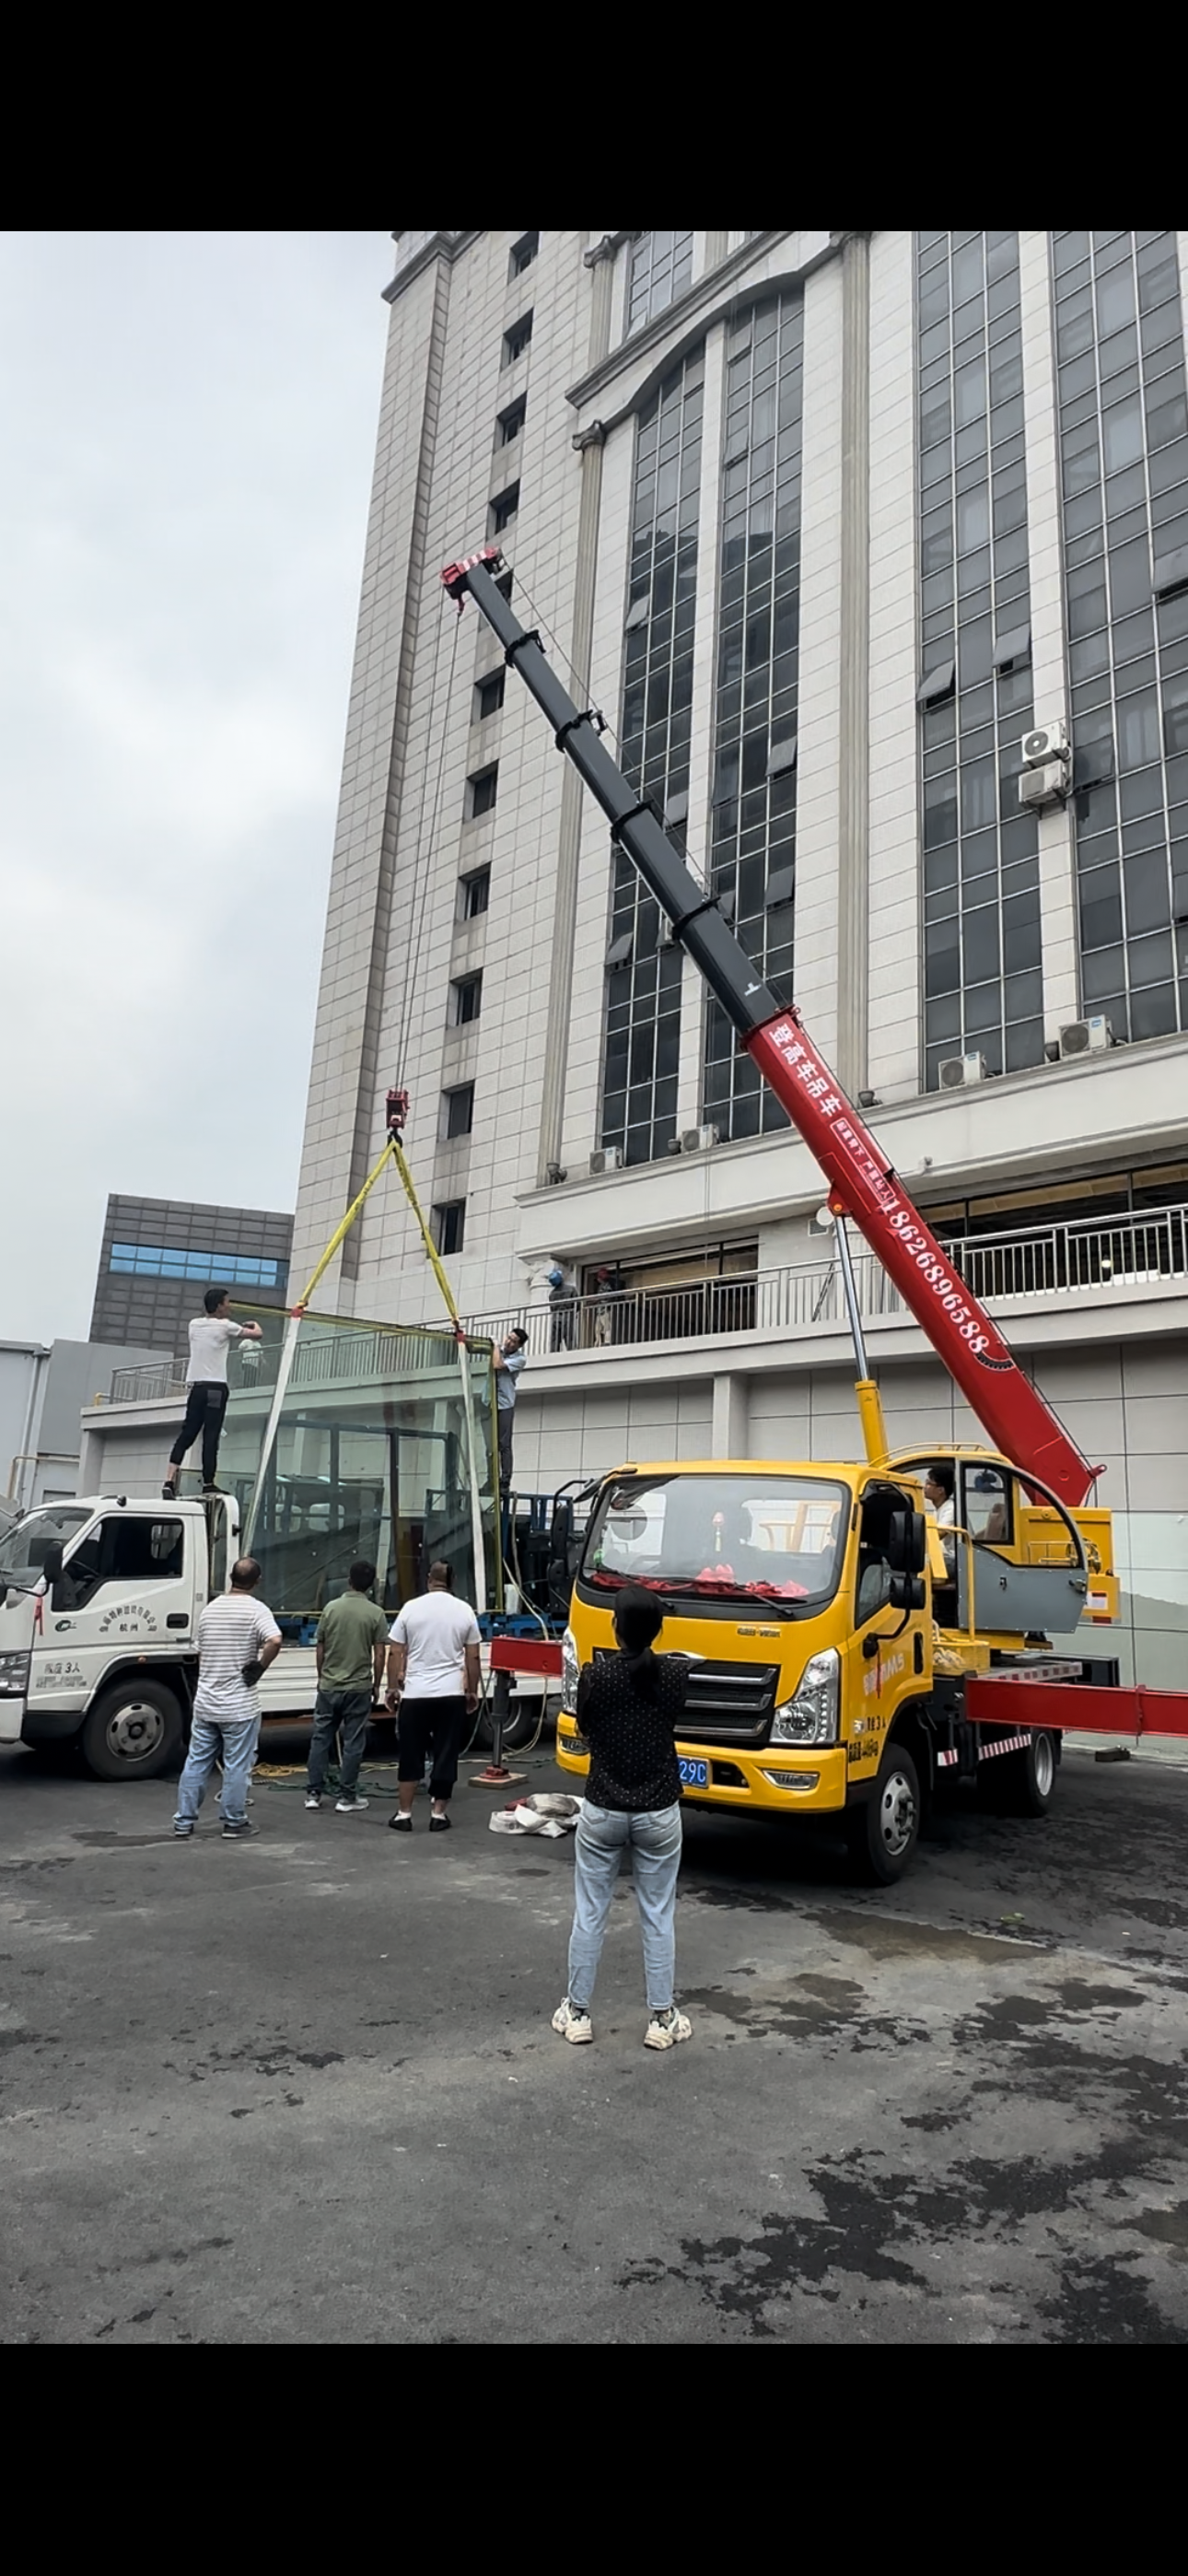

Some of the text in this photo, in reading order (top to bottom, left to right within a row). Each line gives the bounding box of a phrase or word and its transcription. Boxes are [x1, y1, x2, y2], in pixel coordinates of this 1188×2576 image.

[769, 1024, 843, 1118] 登高车吊车
[880, 1198, 990, 1354] 18626896588
